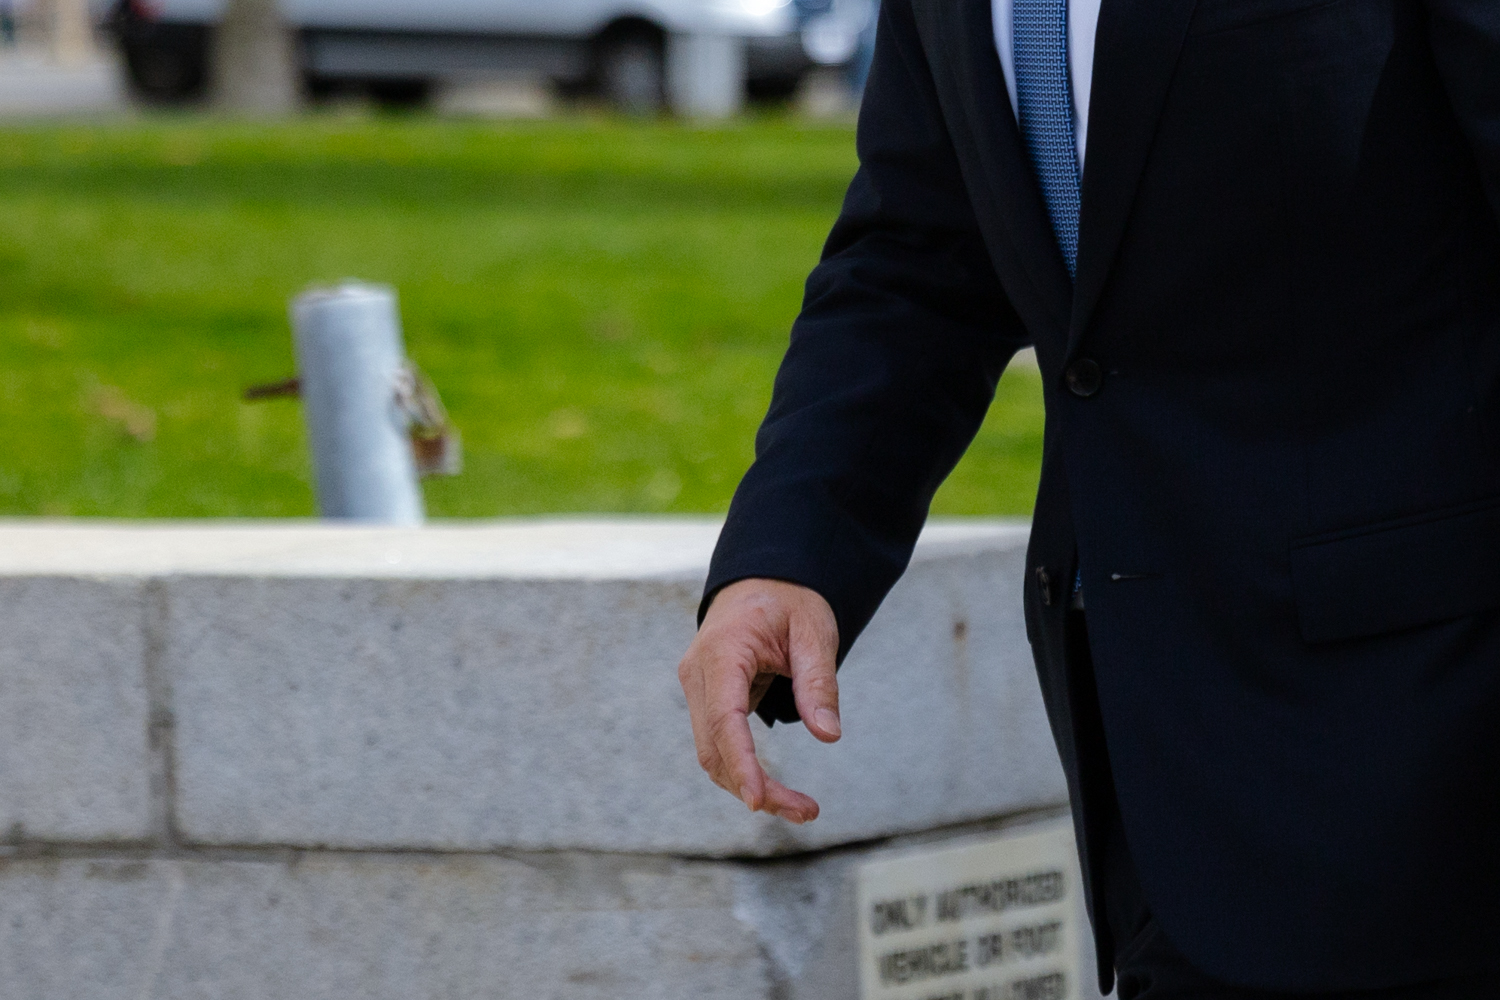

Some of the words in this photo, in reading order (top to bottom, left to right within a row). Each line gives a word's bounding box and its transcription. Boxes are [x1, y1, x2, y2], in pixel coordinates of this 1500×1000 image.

[872, 895, 927, 936] ONLY
[935, 871, 1064, 921] AUTHORIZED
[878, 940, 968, 985] VEHICLE
[975, 933, 1002, 967] OR
[1009, 920, 1062, 957] FOOT
